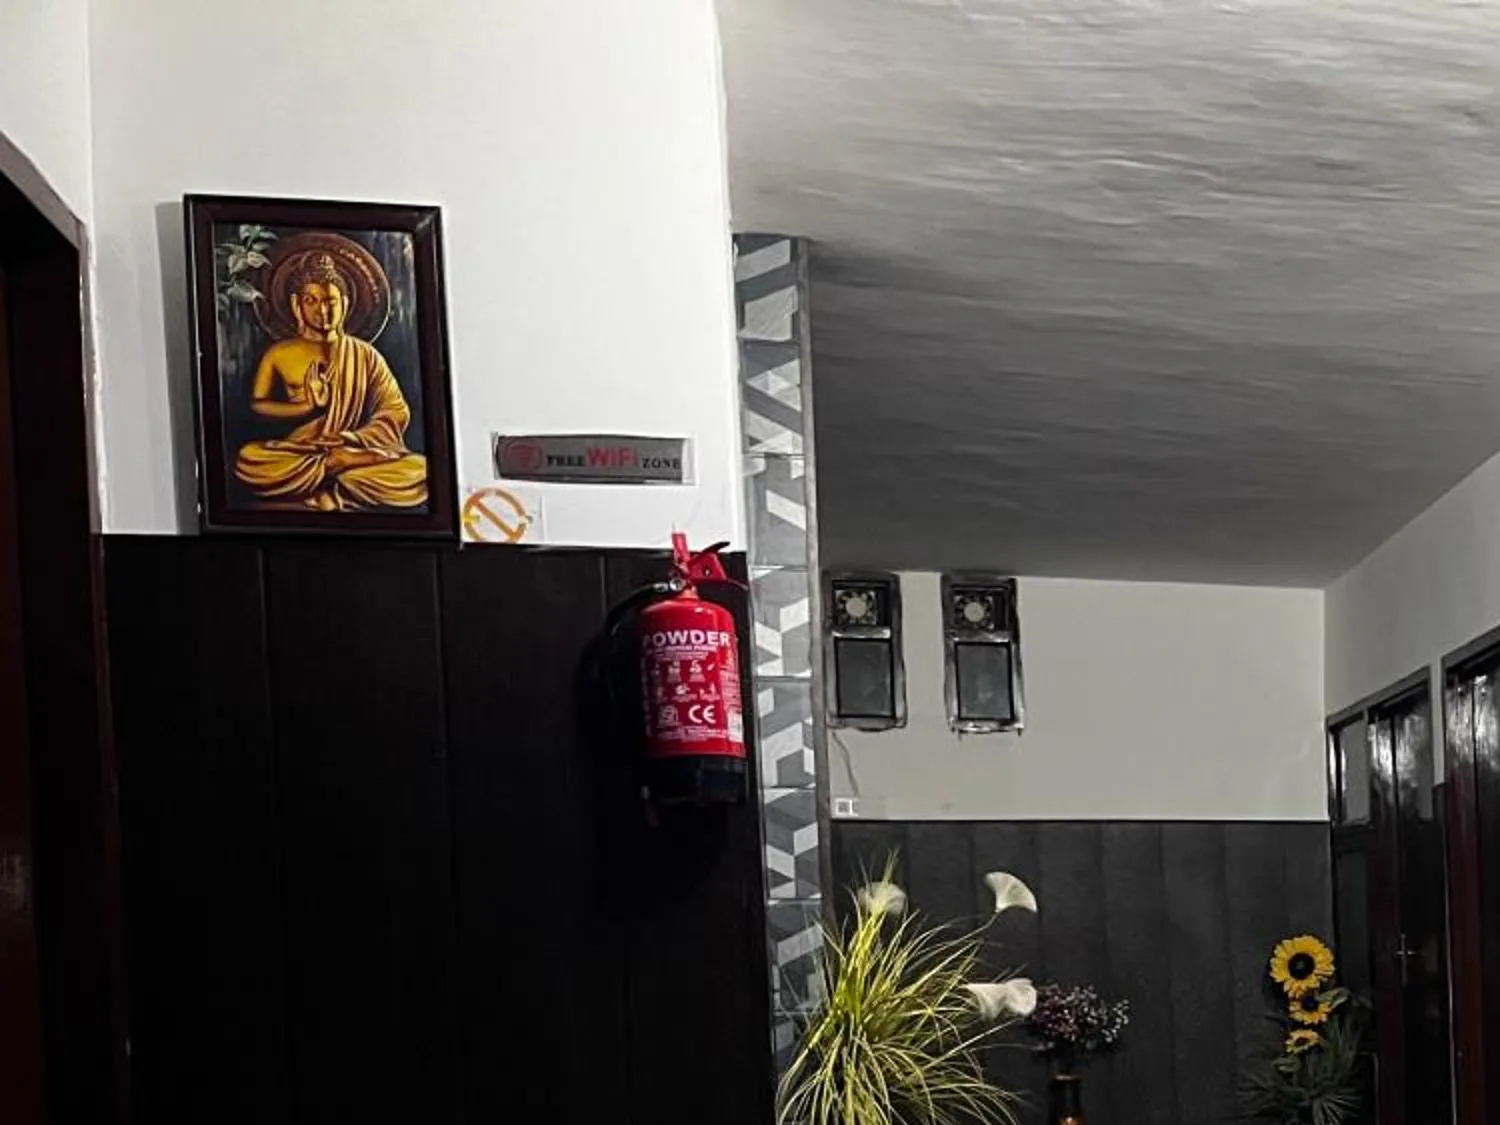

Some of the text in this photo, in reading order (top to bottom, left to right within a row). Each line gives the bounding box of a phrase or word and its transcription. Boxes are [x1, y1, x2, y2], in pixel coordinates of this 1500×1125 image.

[546, 454, 586, 467] FREE
[641, 457, 681, 469] ZONE
[642, 630, 731, 647] POWDER
[688, 704, 717, 725] CE
